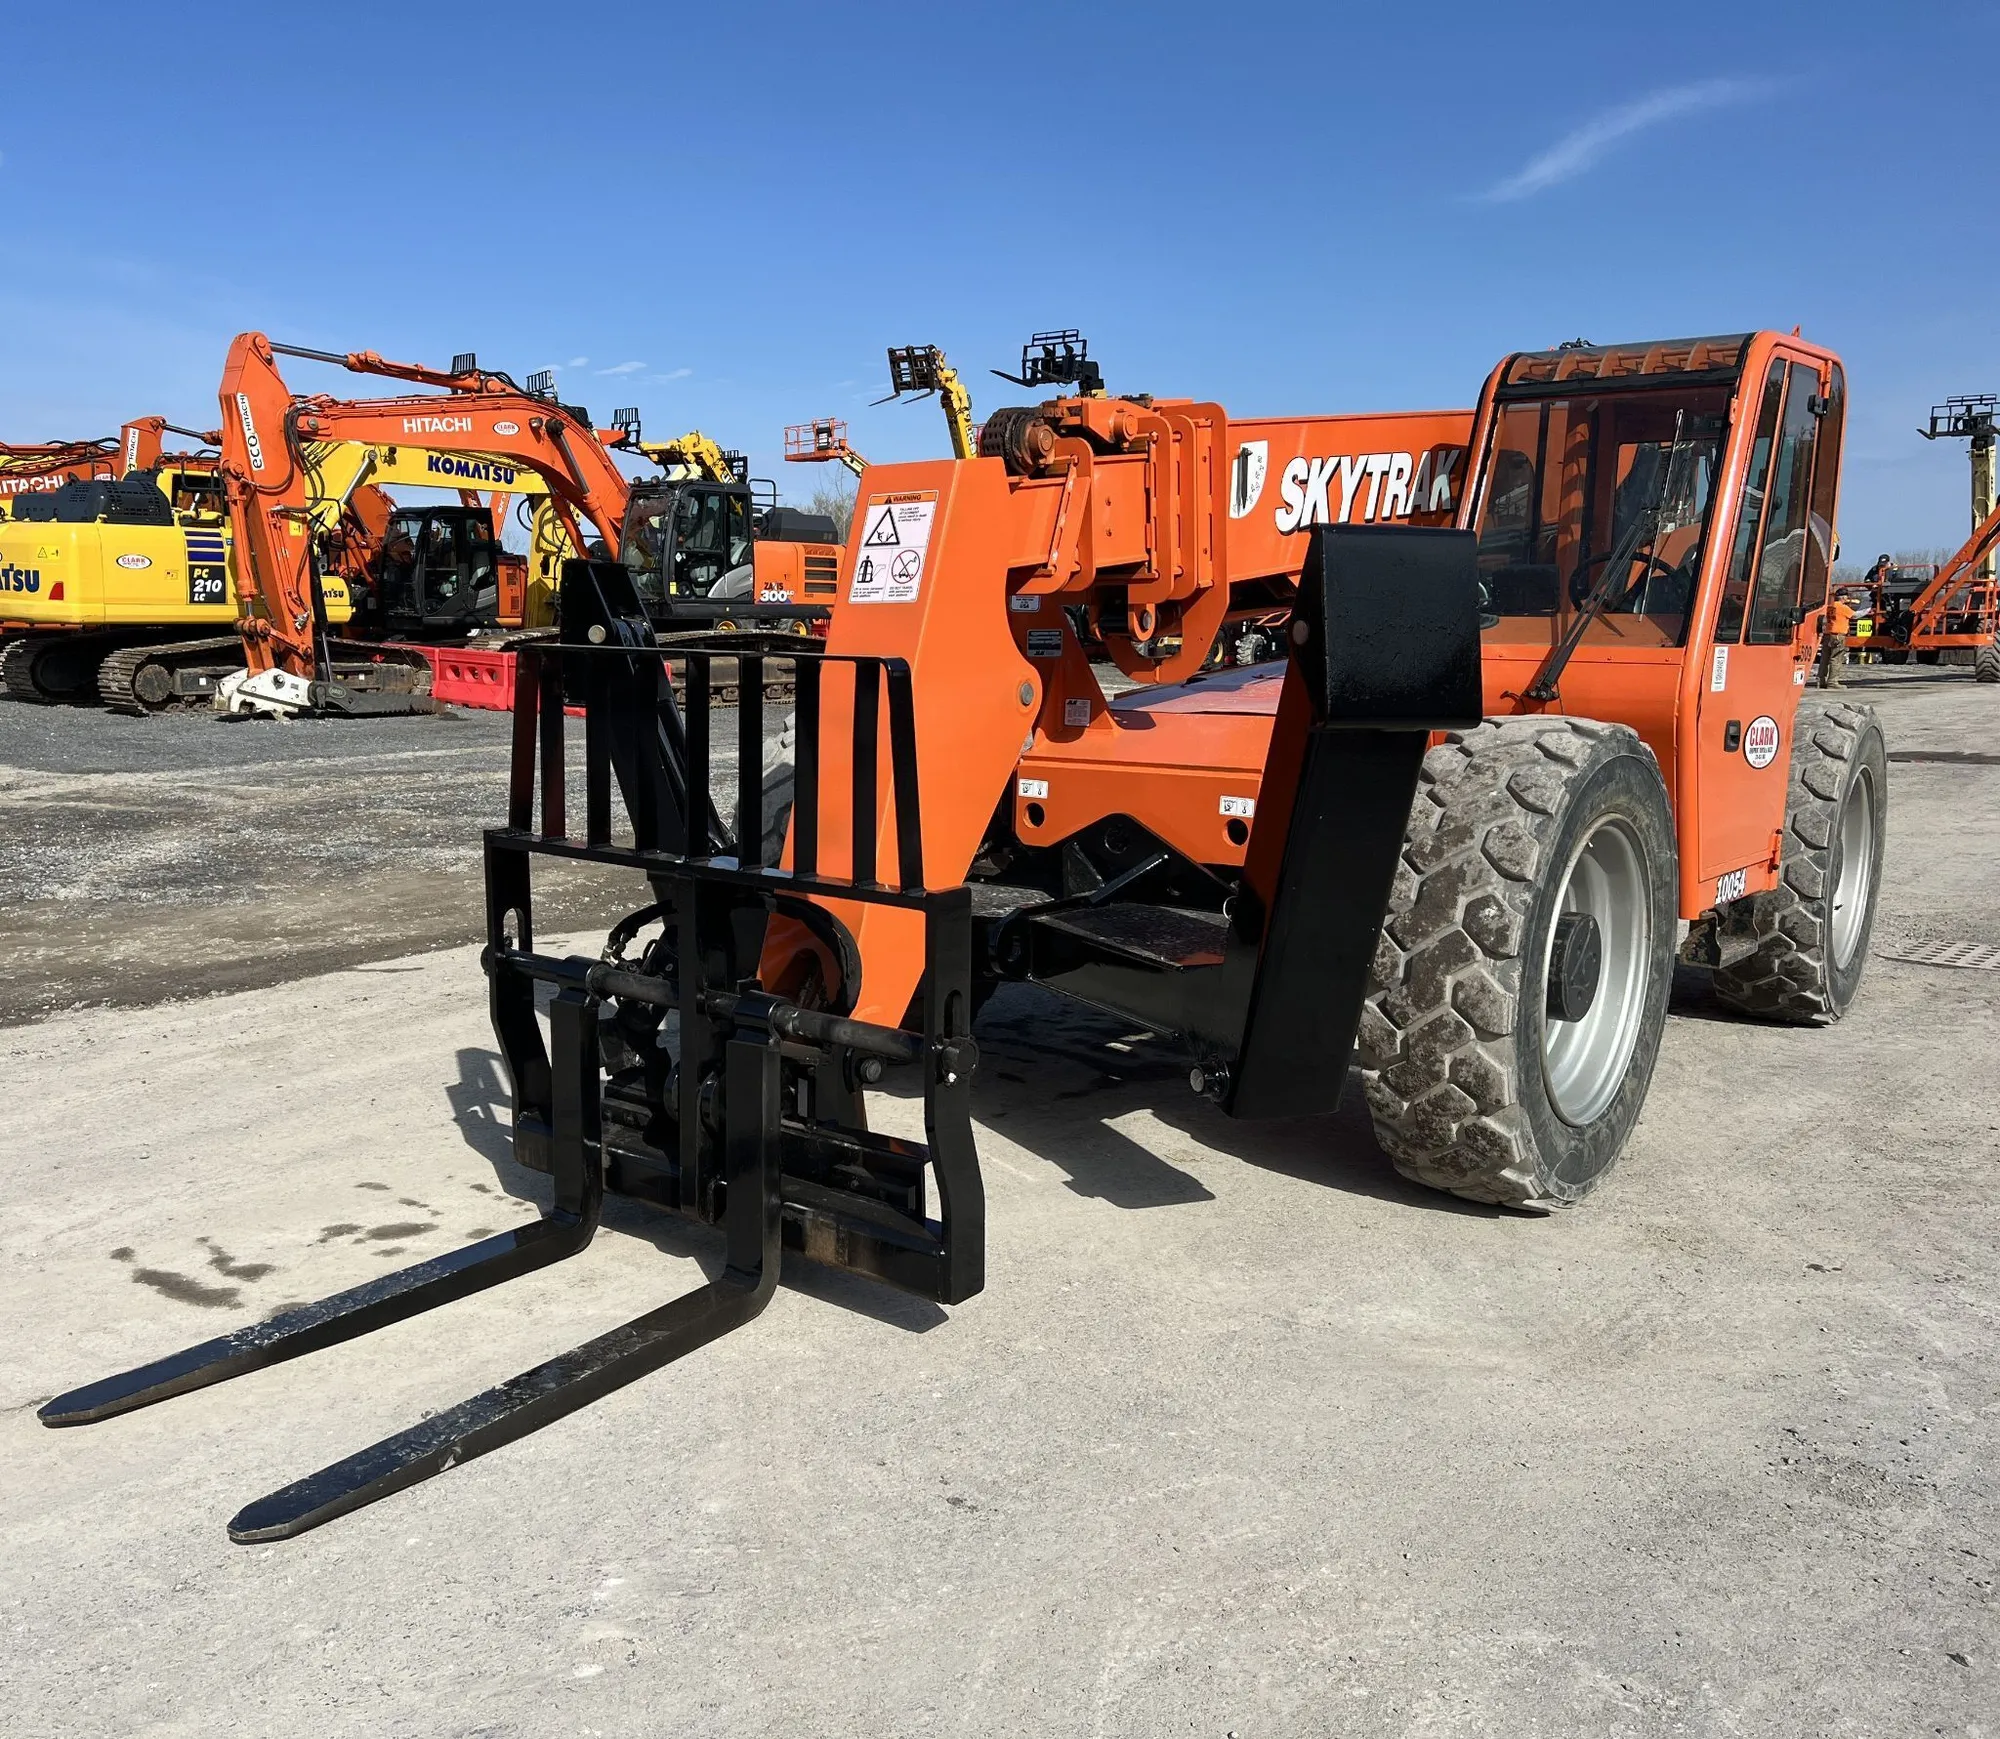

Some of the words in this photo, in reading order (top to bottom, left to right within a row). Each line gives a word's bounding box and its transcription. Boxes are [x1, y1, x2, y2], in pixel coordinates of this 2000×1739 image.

[240, 394, 253, 431] HITACHI
[403, 417, 472, 433] HITACHI
[428, 455, 515, 485] KOMATSU
[893, 494, 922, 502] WARNING
[1275, 449, 1462, 537] SKYTRAK
[193, 568, 210, 579] PC
[193, 579, 222, 593] 210
[764, 581, 784, 591] ZAXIS
[193, 593, 206, 602] LC
[760, 590, 787, 602] 300
[1858, 624, 1872, 632] SOLD
[1750, 726, 1775, 746] CLARK
[1715, 867, 1747, 904] 10054
